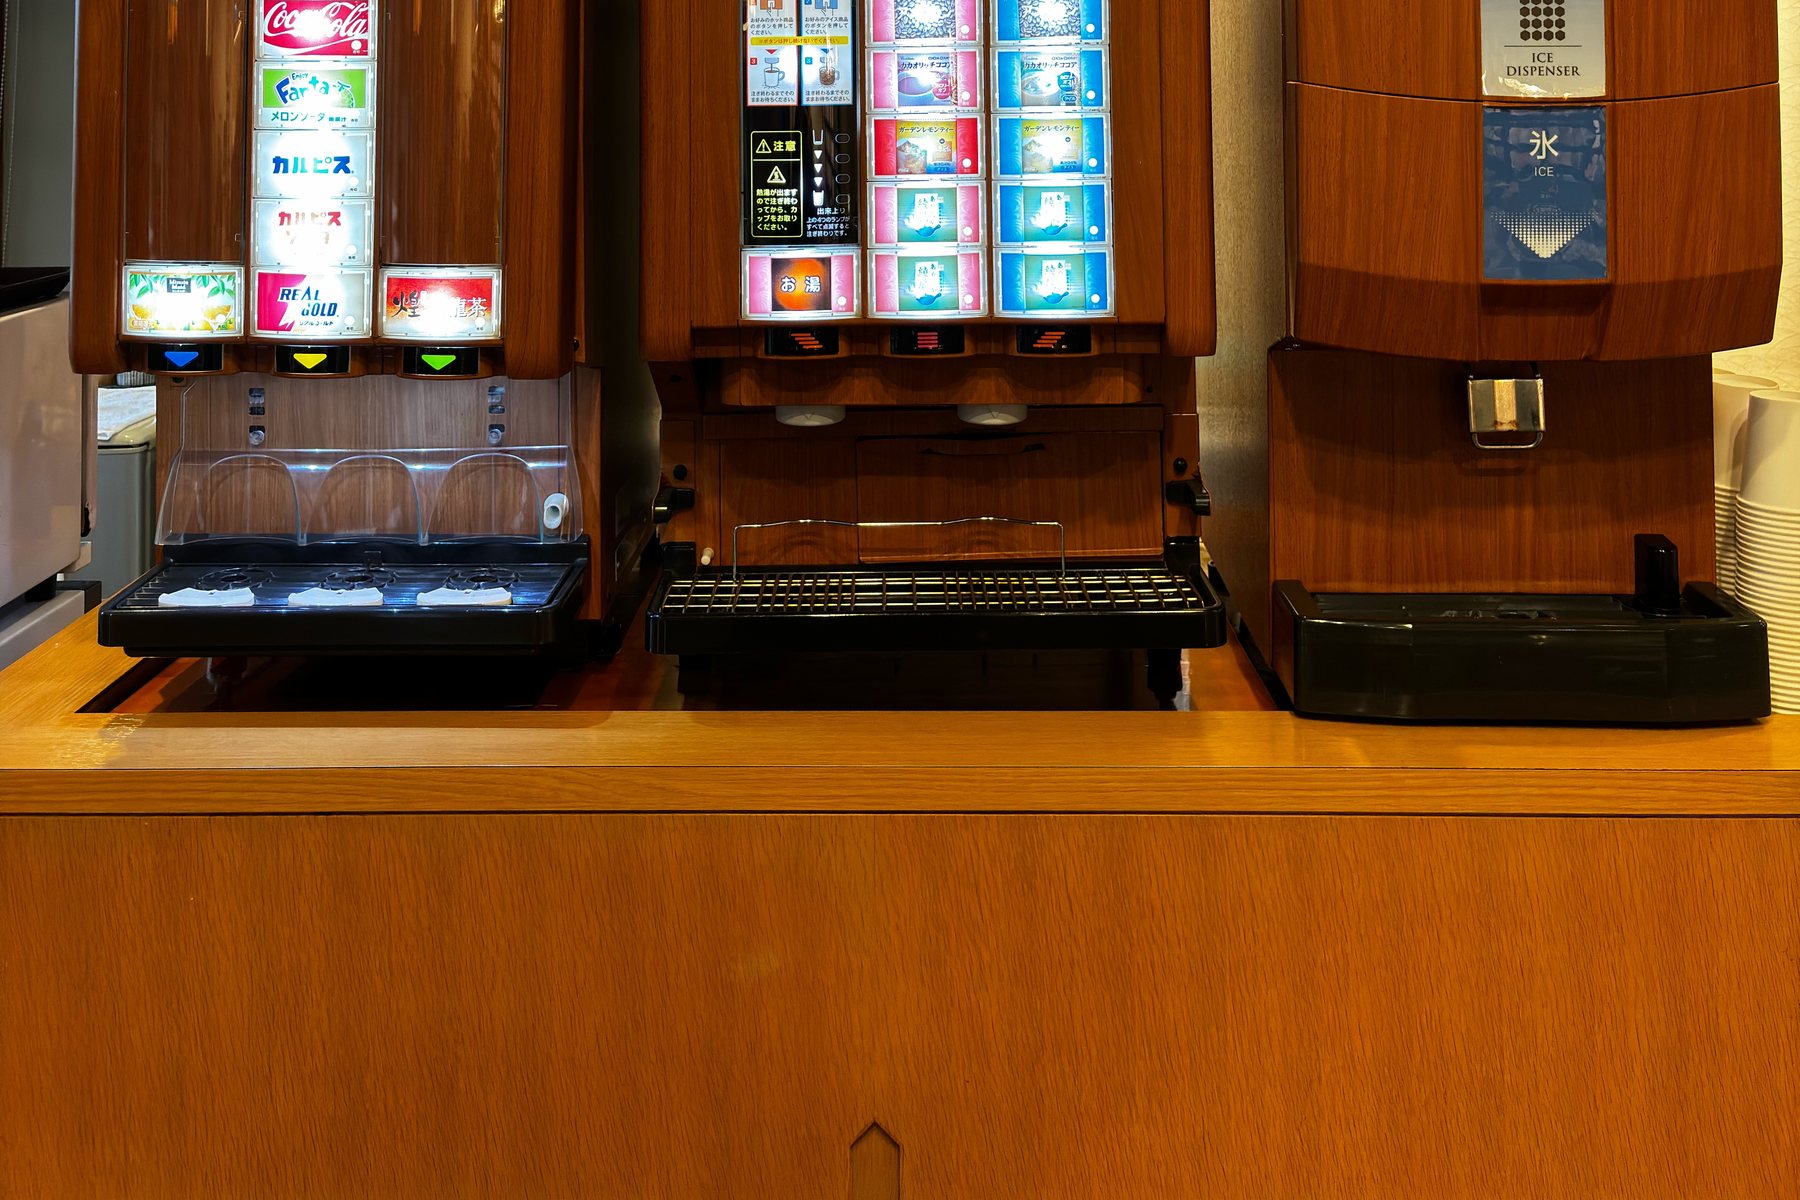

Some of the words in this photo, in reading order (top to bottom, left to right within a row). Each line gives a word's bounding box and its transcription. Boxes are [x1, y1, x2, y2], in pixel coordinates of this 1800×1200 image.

[264, 1, 368, 38] CocCola
[1532, 52, 1554, 63] ICE
[1506, 65, 1581, 77] DISPENSER
[899, 126, 955, 134] ガーデンレモンティー
[773, 140, 796, 152] 注意
[1529, 130, 1559, 160] 氷
[272, 155, 351, 174] カルピス
[1534, 166, 1554, 177] ICE
[756, 188, 798, 197] 熱湯が出ます
[756, 197, 798, 205] ので注ぎ終わ
[757, 206, 798, 214] ってから、カ
[816, 207, 845, 215] 出来上り
[757, 223, 788, 231] ください。
[780, 276, 821, 293] お湯
[280, 286, 321, 300] REAL
